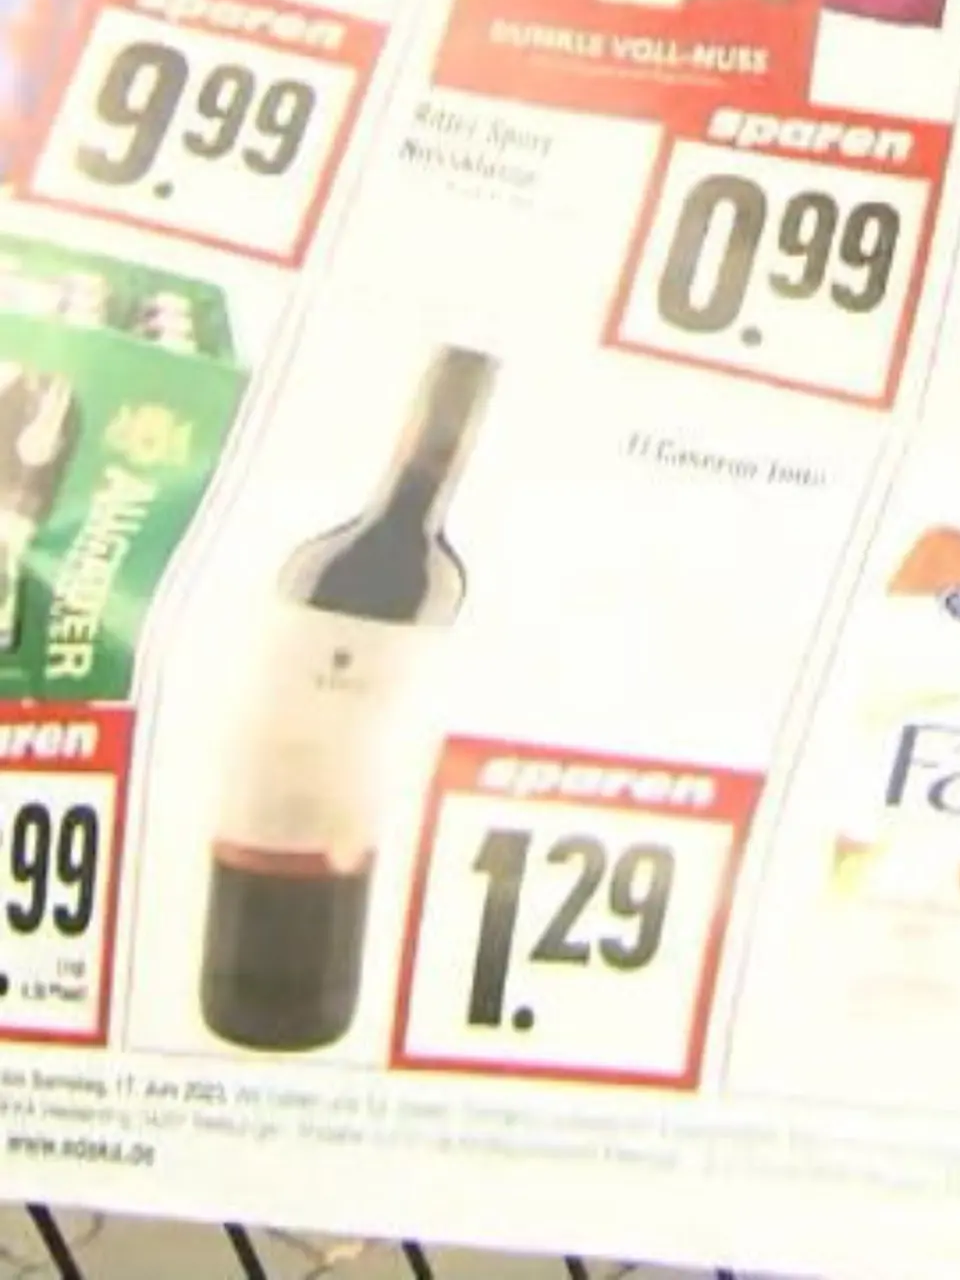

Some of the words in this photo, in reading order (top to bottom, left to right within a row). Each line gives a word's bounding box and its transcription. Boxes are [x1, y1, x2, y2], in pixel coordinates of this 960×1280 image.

[73, 38, 318, 200] 9.99
[707, 109, 913, 161] sparen
[656, 171, 901, 350] 0.99
[477, 756, 716, 808] sparen
[465, 825, 676, 1034] 1.29
